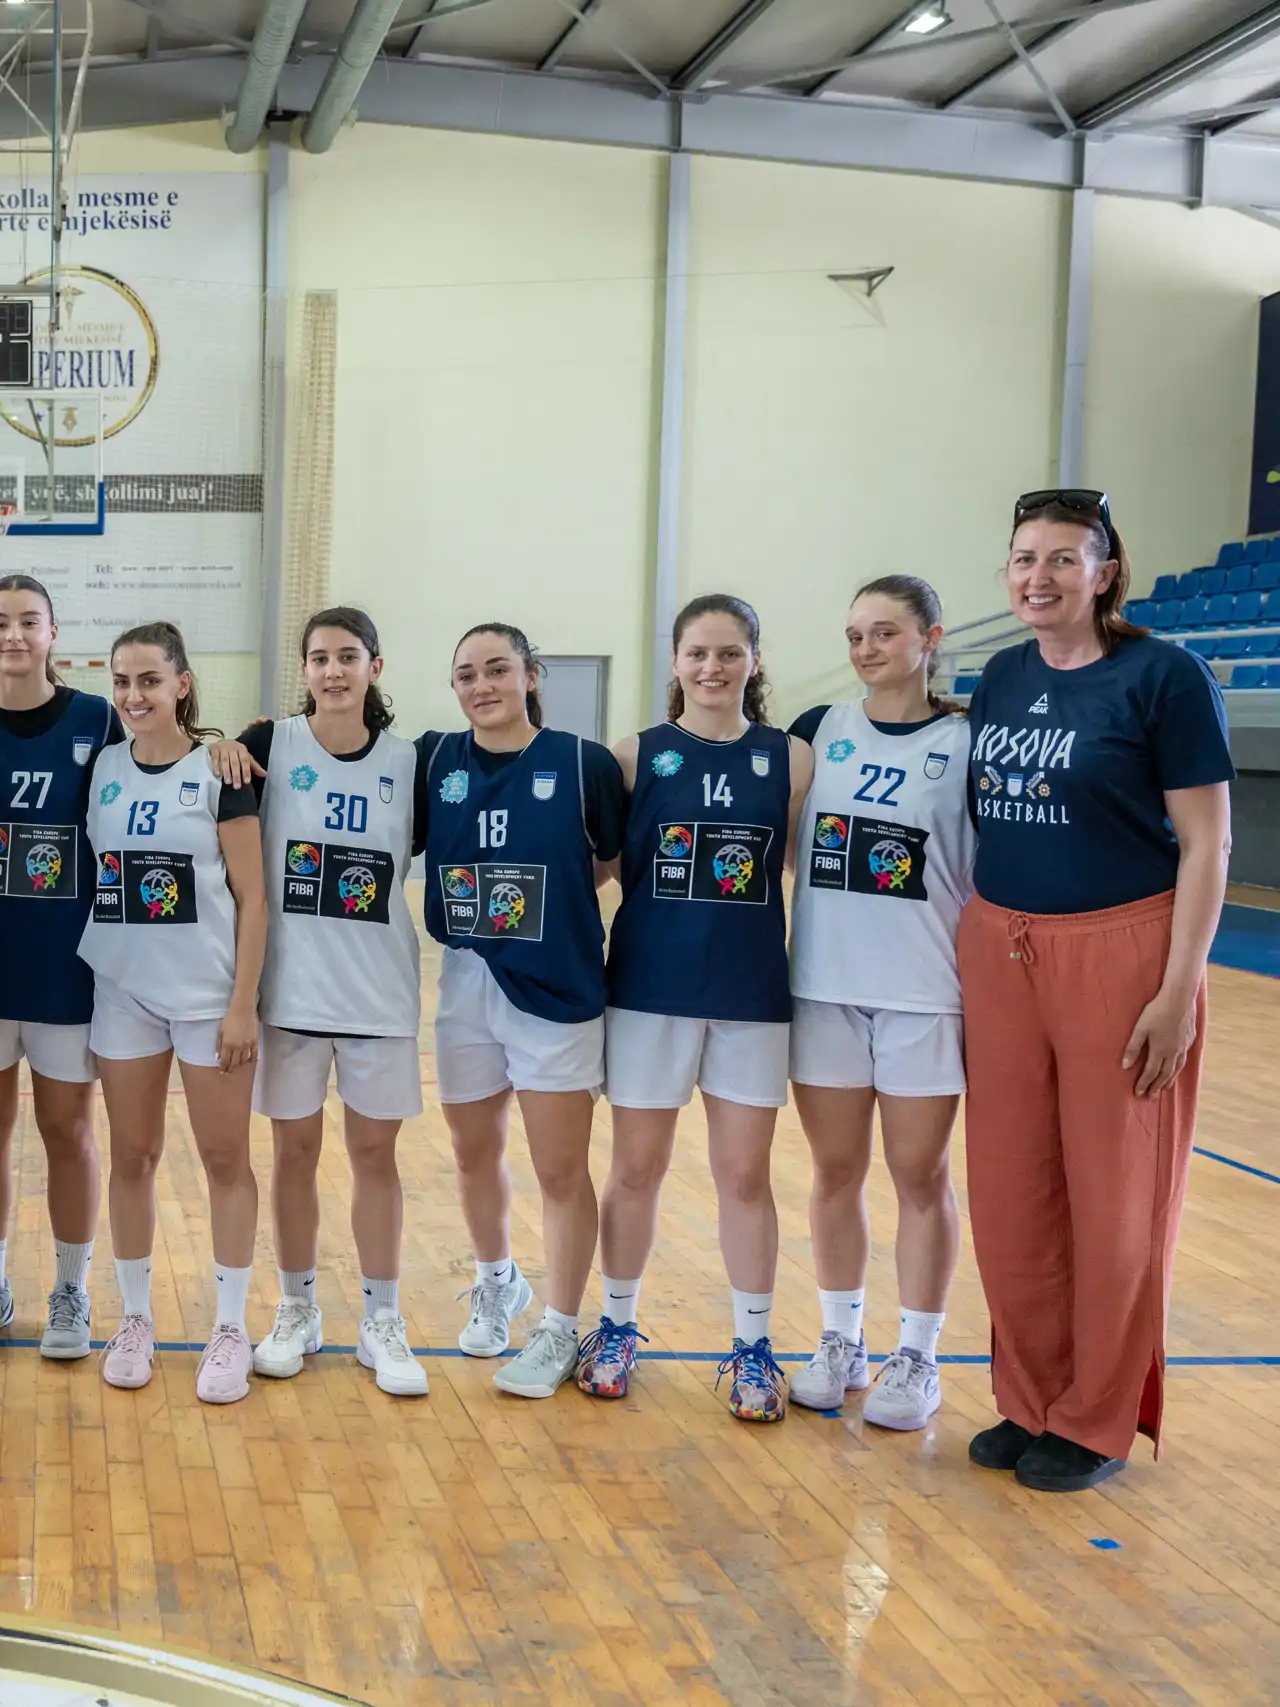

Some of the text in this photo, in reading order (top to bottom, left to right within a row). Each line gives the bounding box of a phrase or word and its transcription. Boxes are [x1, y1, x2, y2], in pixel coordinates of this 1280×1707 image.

[78, 190, 159, 207] mesme
[167, 191, 178, 206] e
[37, 216, 49, 231] e
[32, 350, 136, 388] PERIUM
[31, 484, 70, 505] yë,
[75, 483, 163, 500] shollimi
[167, 483, 214, 504] juaj!
[1028, 706, 1049, 714] PEAK
[972, 723, 1076, 769] KOSOVA
[10, 771, 53, 809] 27
[702, 773, 733, 808] 14
[853, 763, 907, 807] 22
[126, 800, 160, 836] 13
[324, 792, 368, 834] 30
[477, 809, 508, 848] 18
[661, 865, 686, 879] FIBA
[815, 856, 841, 871] FIBA
[96, 893, 118, 905] FIBA
[288, 882, 314, 896] FIBA
[451, 905, 474, 918] FIBA
